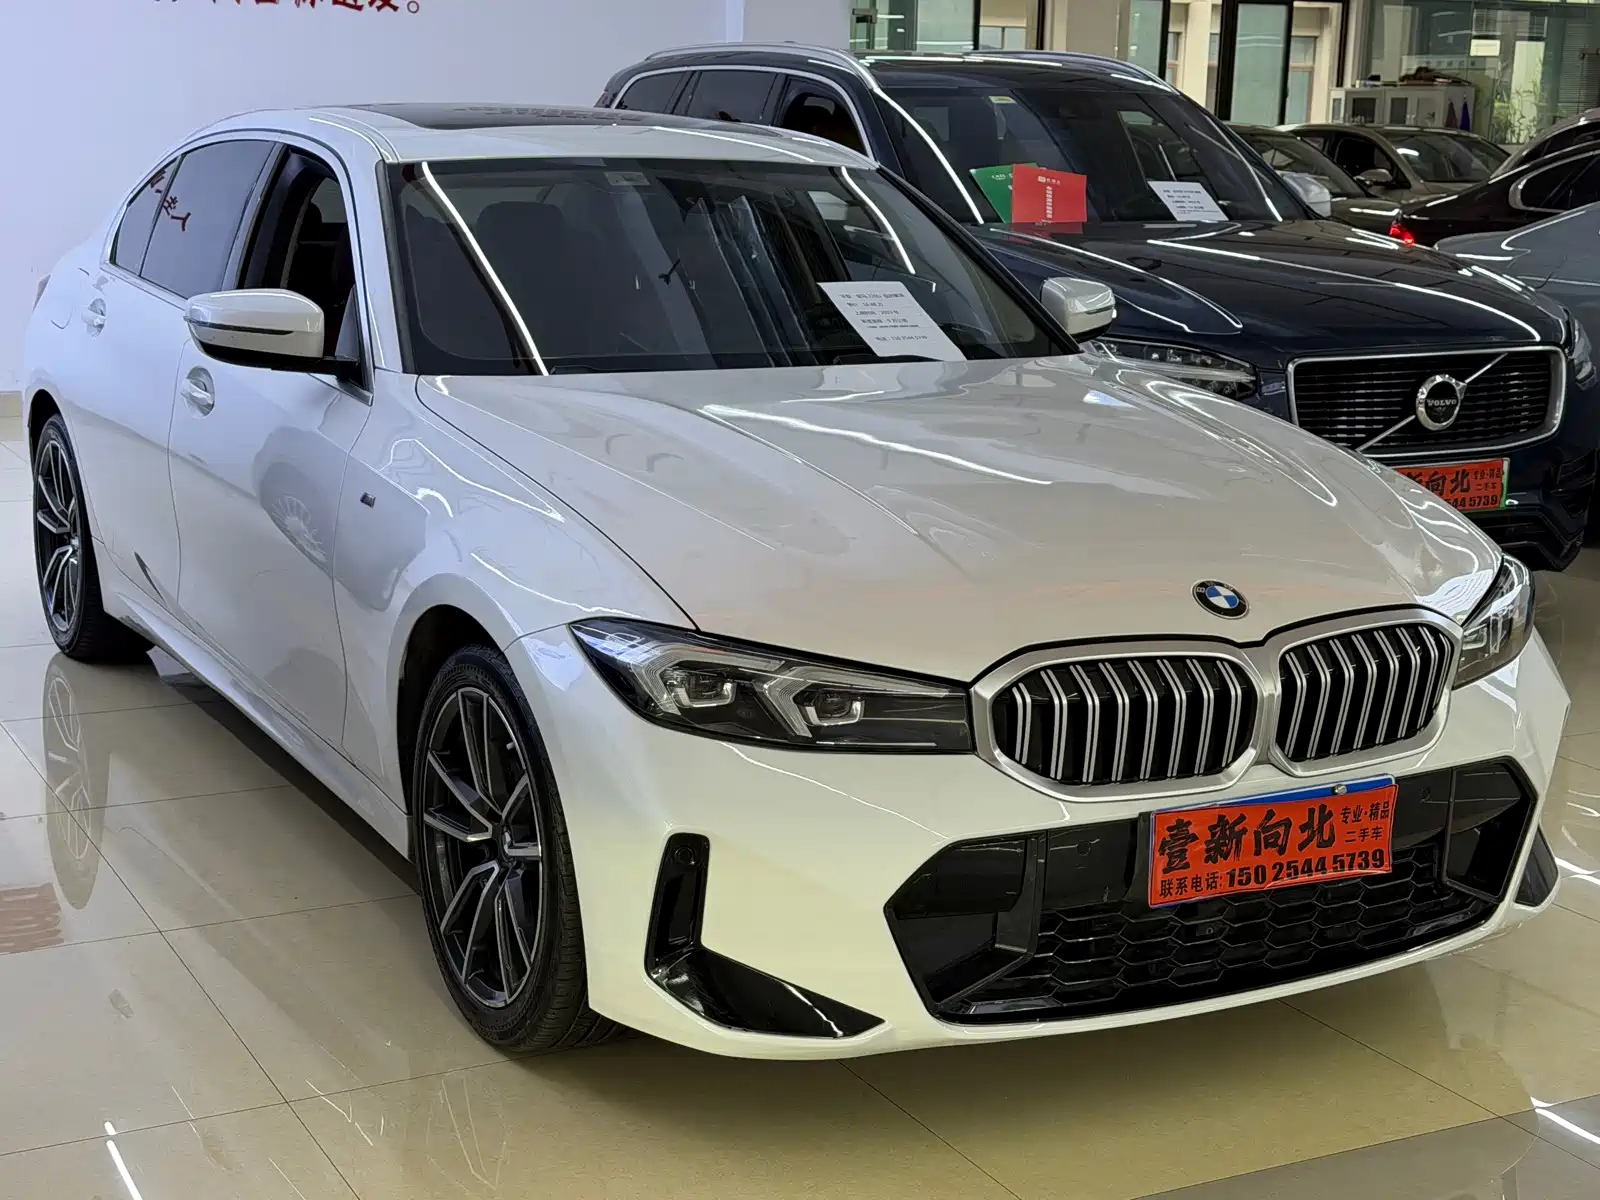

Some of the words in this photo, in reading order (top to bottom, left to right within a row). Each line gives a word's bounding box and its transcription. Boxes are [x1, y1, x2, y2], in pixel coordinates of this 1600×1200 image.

[1468, 494, 1498, 507] 5739
[1158, 804, 1336, 875] 壹新向北
[1345, 826, 1383, 843] 二手车
[1227, 864, 1267, 888] 150
[1271, 856, 1328, 882] 2544
[1332, 848, 1385, 872] 5739
